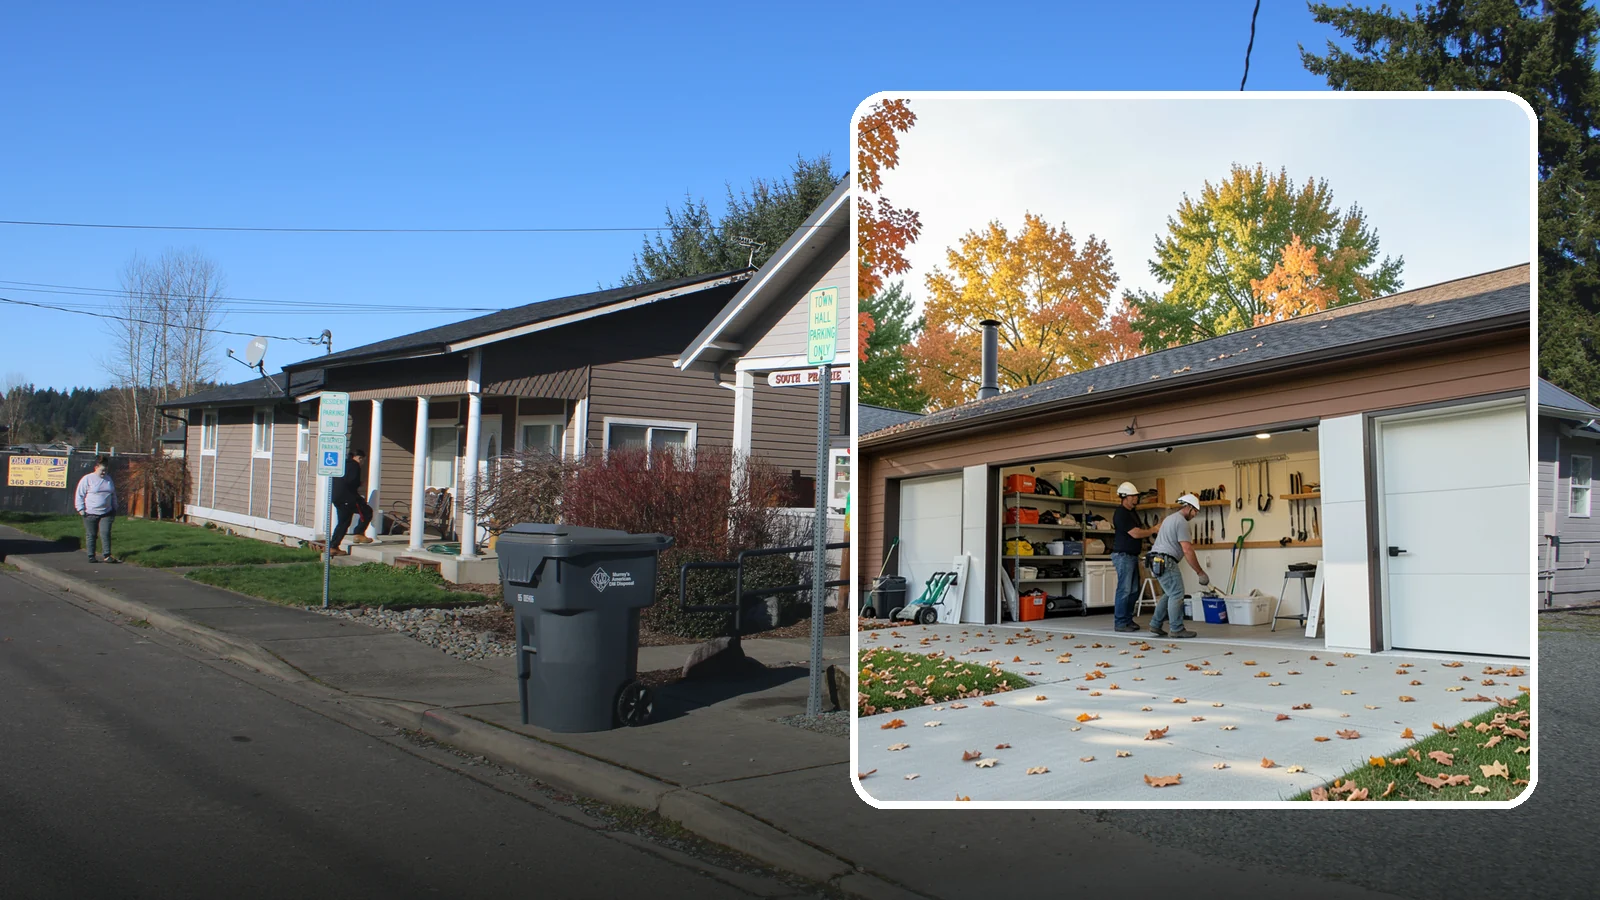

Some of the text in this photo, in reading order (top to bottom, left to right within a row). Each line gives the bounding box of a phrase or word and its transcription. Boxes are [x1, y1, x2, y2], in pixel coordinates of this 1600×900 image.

[815, 295, 832, 308] TOWN
[815, 312, 831, 324] HALL
[809, 327, 835, 340] PARKING
[814, 344, 830, 357] ONLY
[775, 373, 800, 384] SOUTH
[325, 420, 340, 428] ONLY
